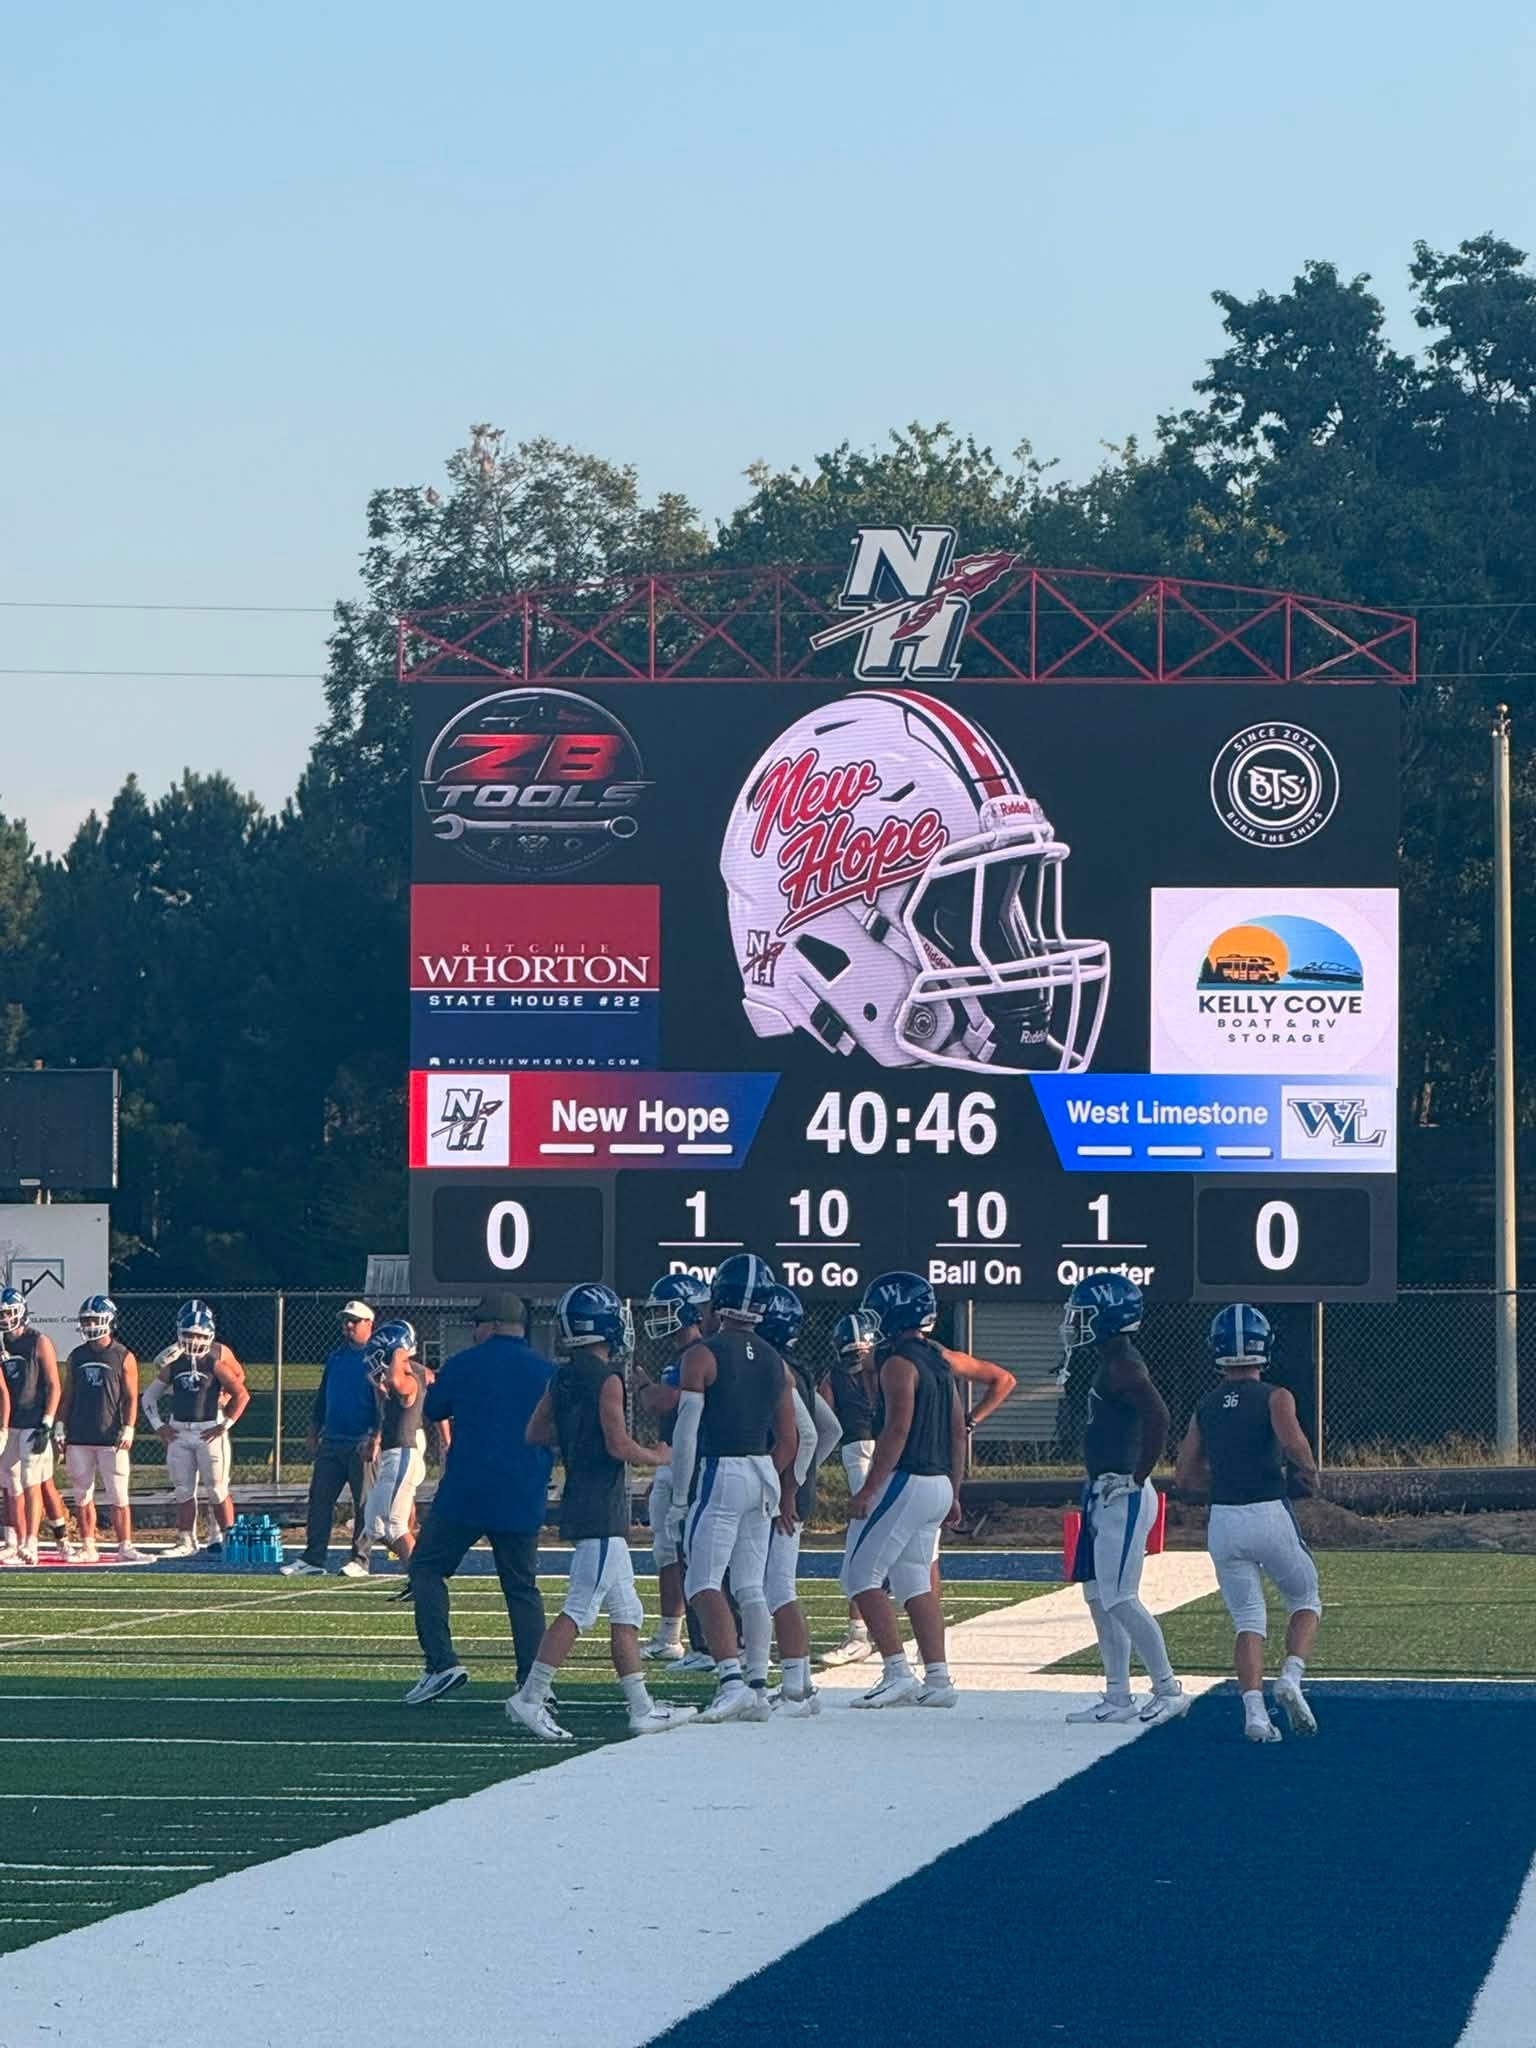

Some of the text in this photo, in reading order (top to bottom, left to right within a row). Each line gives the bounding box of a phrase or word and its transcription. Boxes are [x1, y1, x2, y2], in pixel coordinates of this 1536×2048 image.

[1233, 728, 1317, 752] SINCE 2024
[436, 785, 646, 808] TOOLS
[751, 748, 882, 856] New
[1226, 811, 1323, 842] BURN THE SHIPS
[777, 808, 949, 909] Hope
[461, 944, 609, 953] RITCHIE
[419, 956, 650, 984] WHORTON
[429, 996, 640, 1007] STATE HOUSE #22
[1199, 995, 1362, 1014] KELLY COVE
[1217, 1018, 1338, 1028] BOAT & RV
[1228, 1033, 1325, 1043] STORAGE
[552, 1100, 729, 1140] New Hope
[806, 1091, 998, 1155] 40:46
[1067, 1100, 1268, 1125] West Limestone
[1287, 1098, 1387, 1148] WL
[685, 1190, 706, 1237] 1
[789, 1190, 849, 1236] 10
[947, 1191, 1007, 1239] 10
[1088, 1194, 1109, 1240] 1
[486, 1200, 530, 1270] 0
[1255, 1200, 1300, 1270] 0
[669, 1261, 718, 1285] Dow
[783, 1262, 858, 1287] To Go
[929, 1260, 1021, 1285] Ball On
[880, 1282, 911, 1306] WL
[1089, 1283, 1124, 1306] WL
[746, 1346, 754, 1360] 6
[1223, 1394, 1239, 1408] 36
